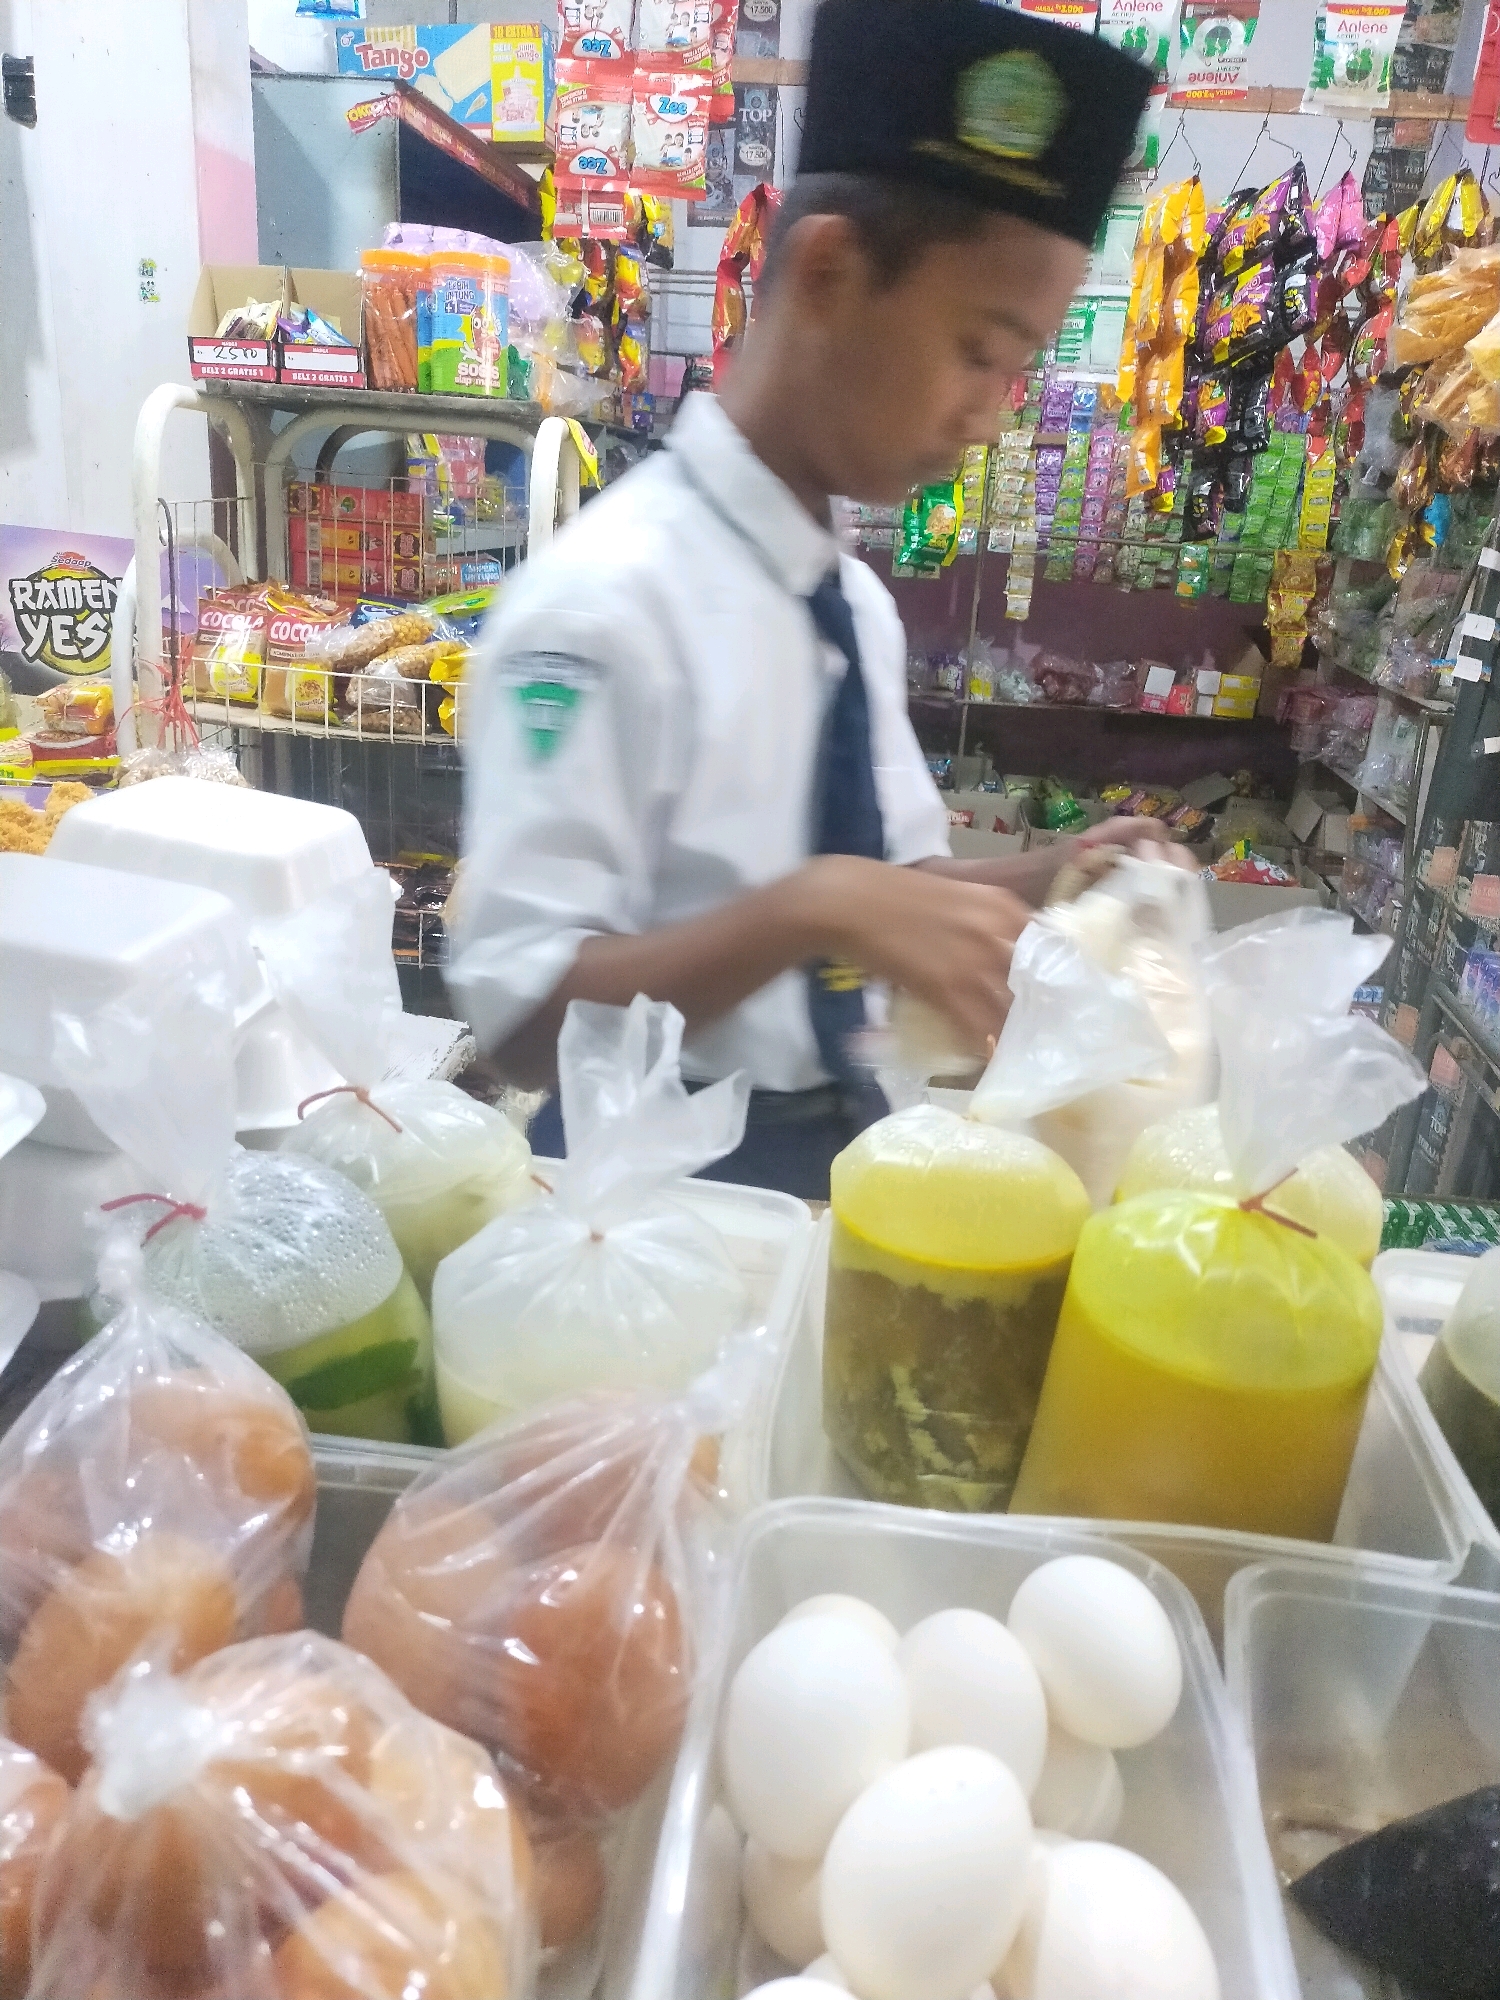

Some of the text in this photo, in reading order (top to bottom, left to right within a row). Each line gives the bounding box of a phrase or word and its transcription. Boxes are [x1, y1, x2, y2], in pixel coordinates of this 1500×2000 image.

[1337, 19, 1388, 34] Anlene
[581, 38, 612, 58] Zee
[355, 42, 430, 79] Tango
[1188, 71, 1240, 85] Anlene
[658, 96, 688, 116] Zee
[738, 108, 774, 122] TOP
[577, 155, 608, 175] Zee
[202, 367, 264, 377] BELI 2 GRATIS 1
[292, 372, 354, 383] BELI 2 GRATIS 1
[51, 555, 92, 568] Sedaap
[12, 580, 122, 611] RAMEN
[201, 611, 265, 631] COCOLA
